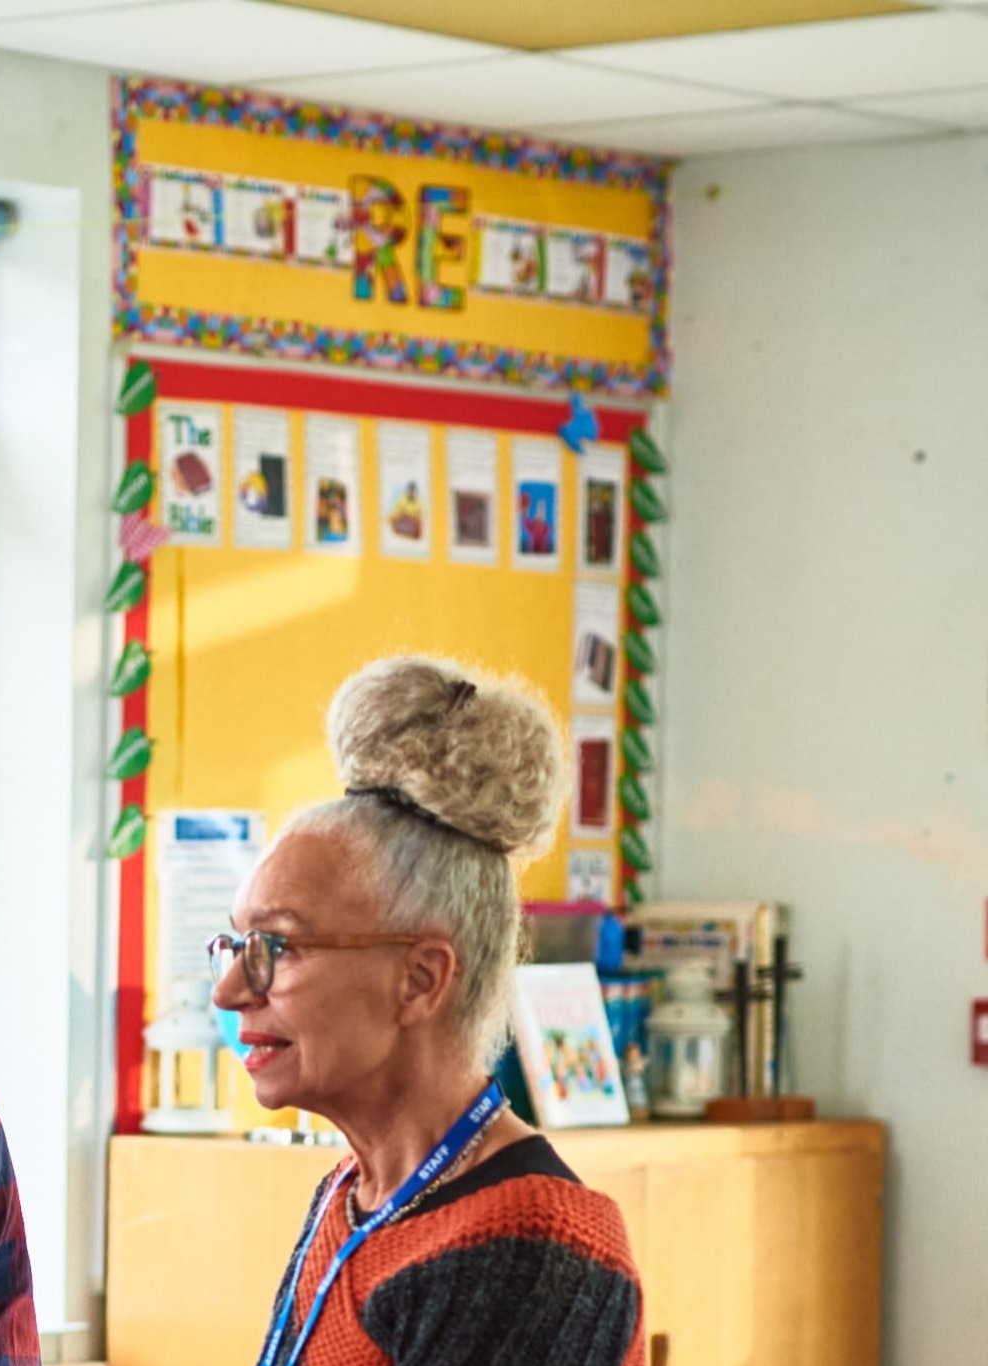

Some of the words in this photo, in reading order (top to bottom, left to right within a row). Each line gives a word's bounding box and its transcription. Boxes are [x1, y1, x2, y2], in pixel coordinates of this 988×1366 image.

[350, 172, 469, 312] RE
[168, 415, 212, 446] The
[419, 1145, 449, 1179] STAFF
